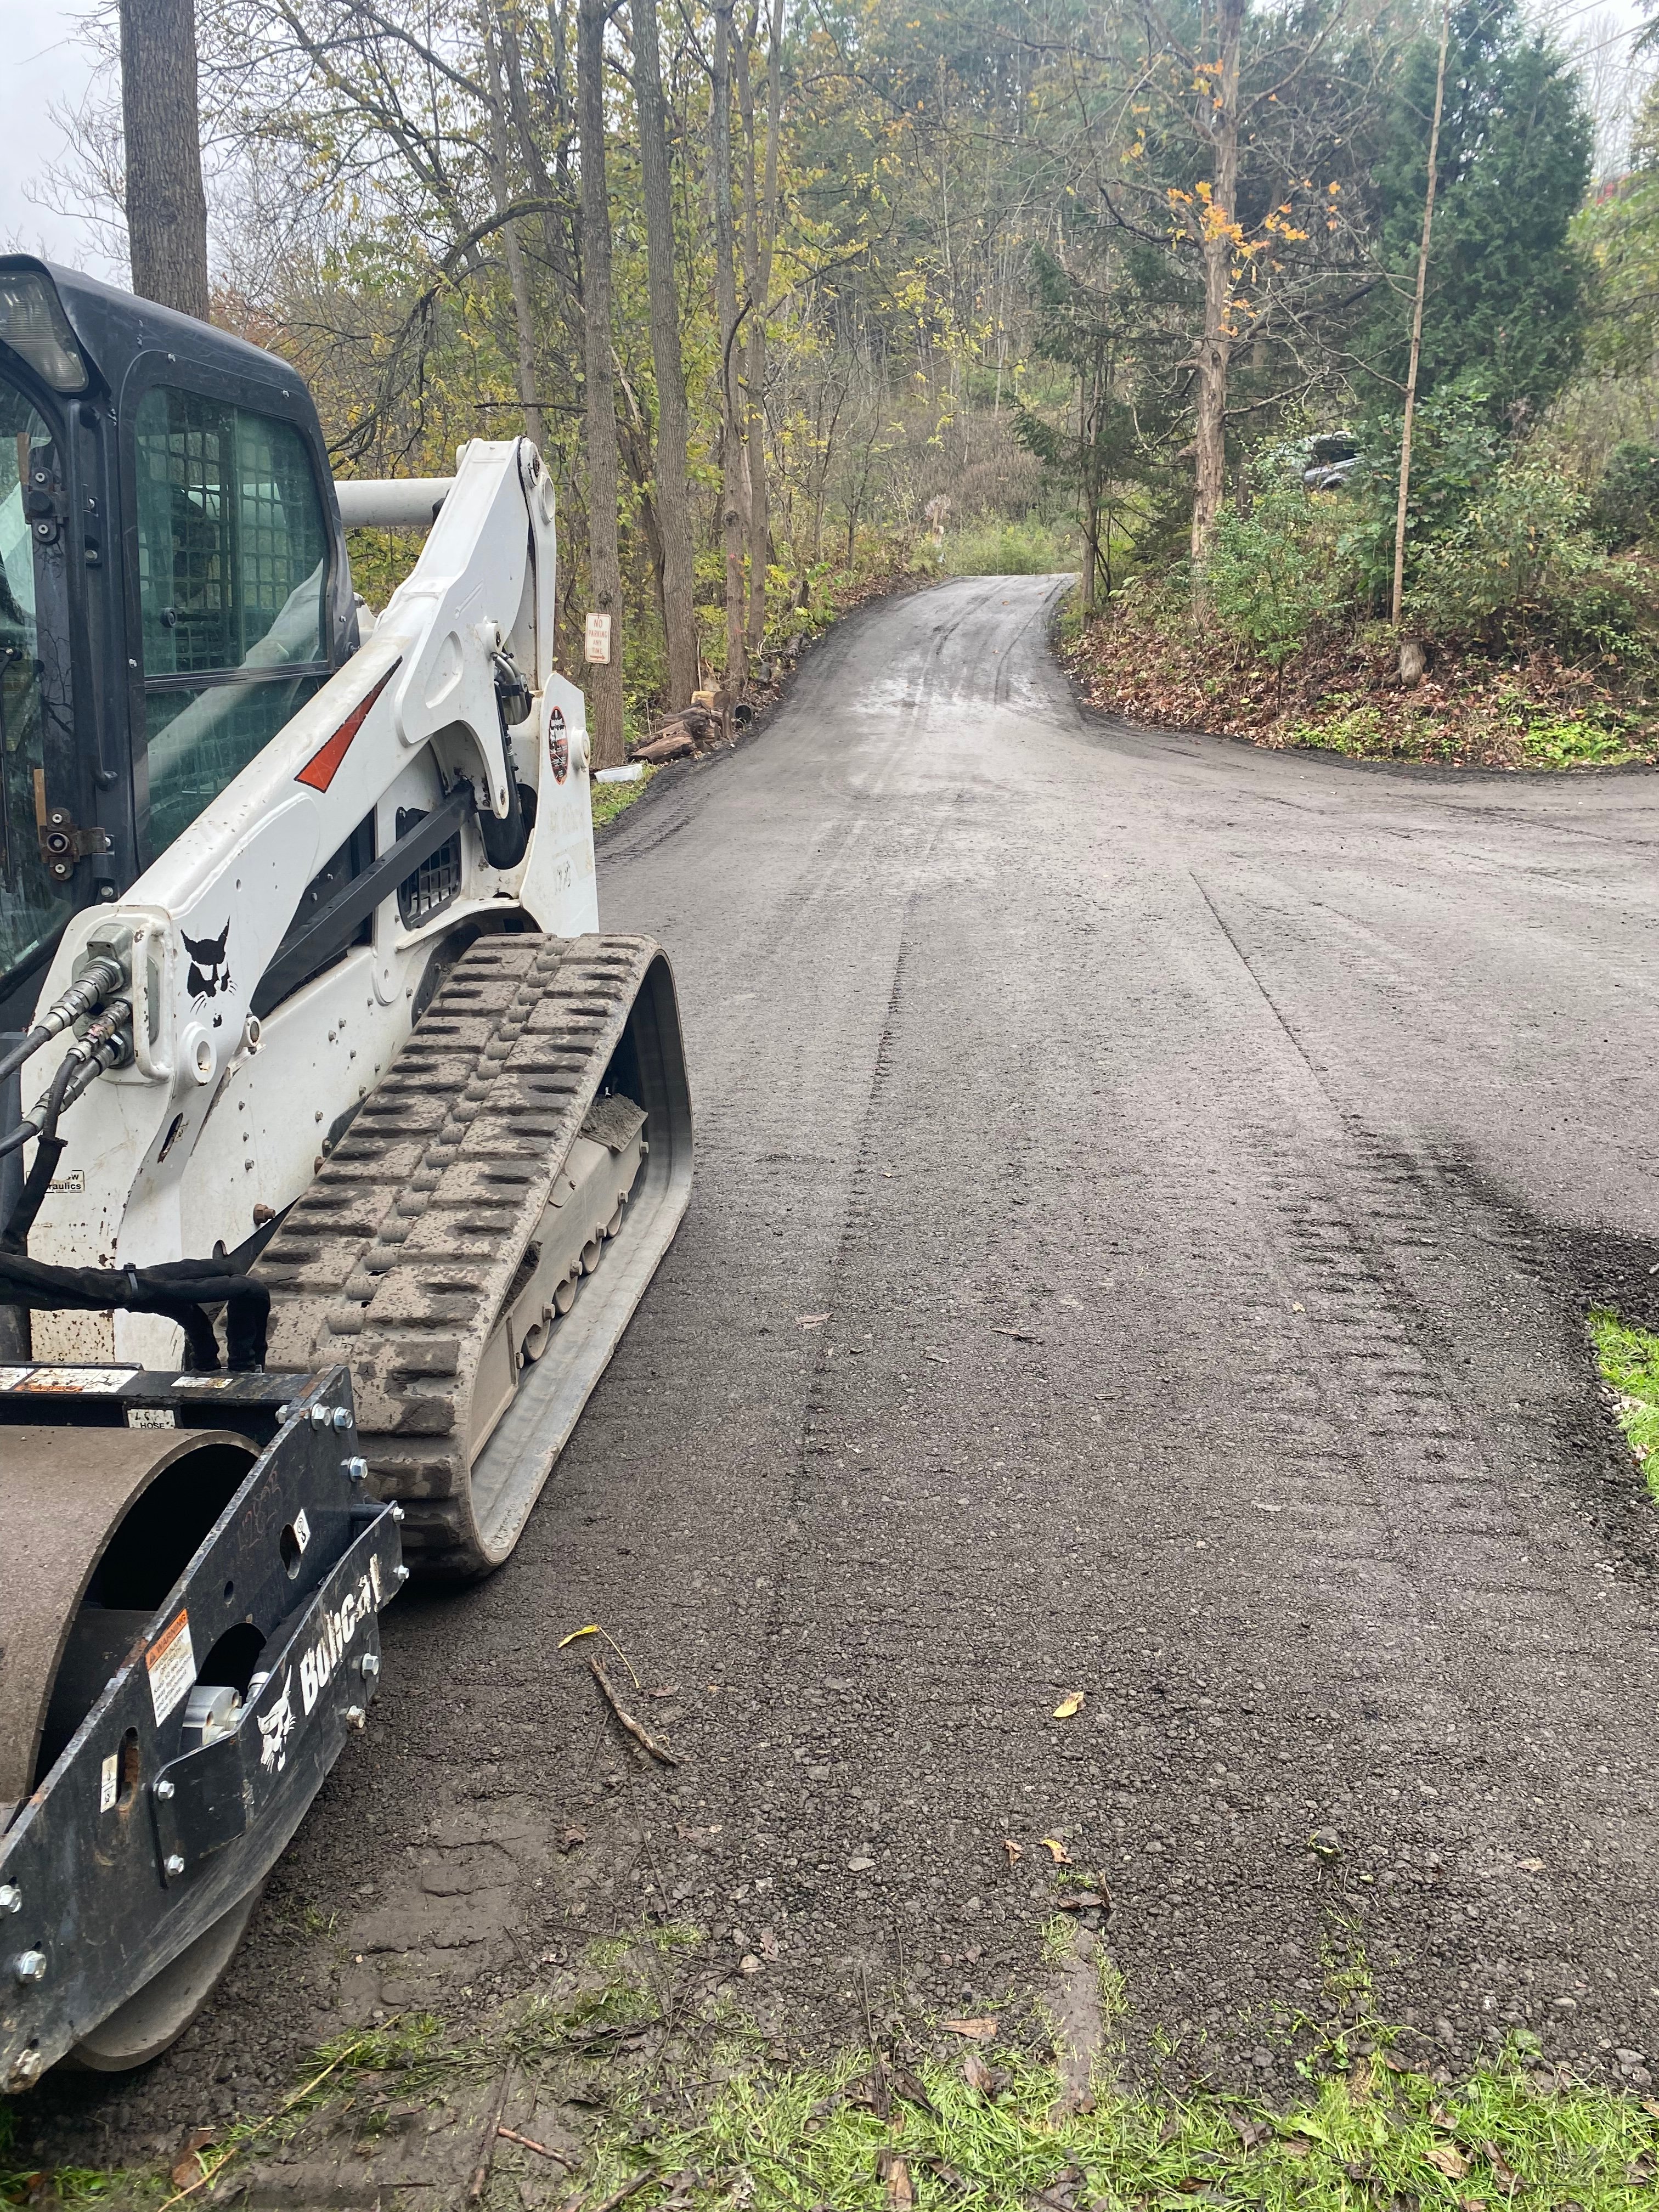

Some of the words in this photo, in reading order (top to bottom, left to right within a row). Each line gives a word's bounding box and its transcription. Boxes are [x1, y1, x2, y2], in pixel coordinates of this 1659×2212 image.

[594, 619, 602, 628] NO
[588, 630, 607, 638] PARKING
[156, 1614, 186, 1653] WARNING
[167, 1646, 181, 1666] DEATH
